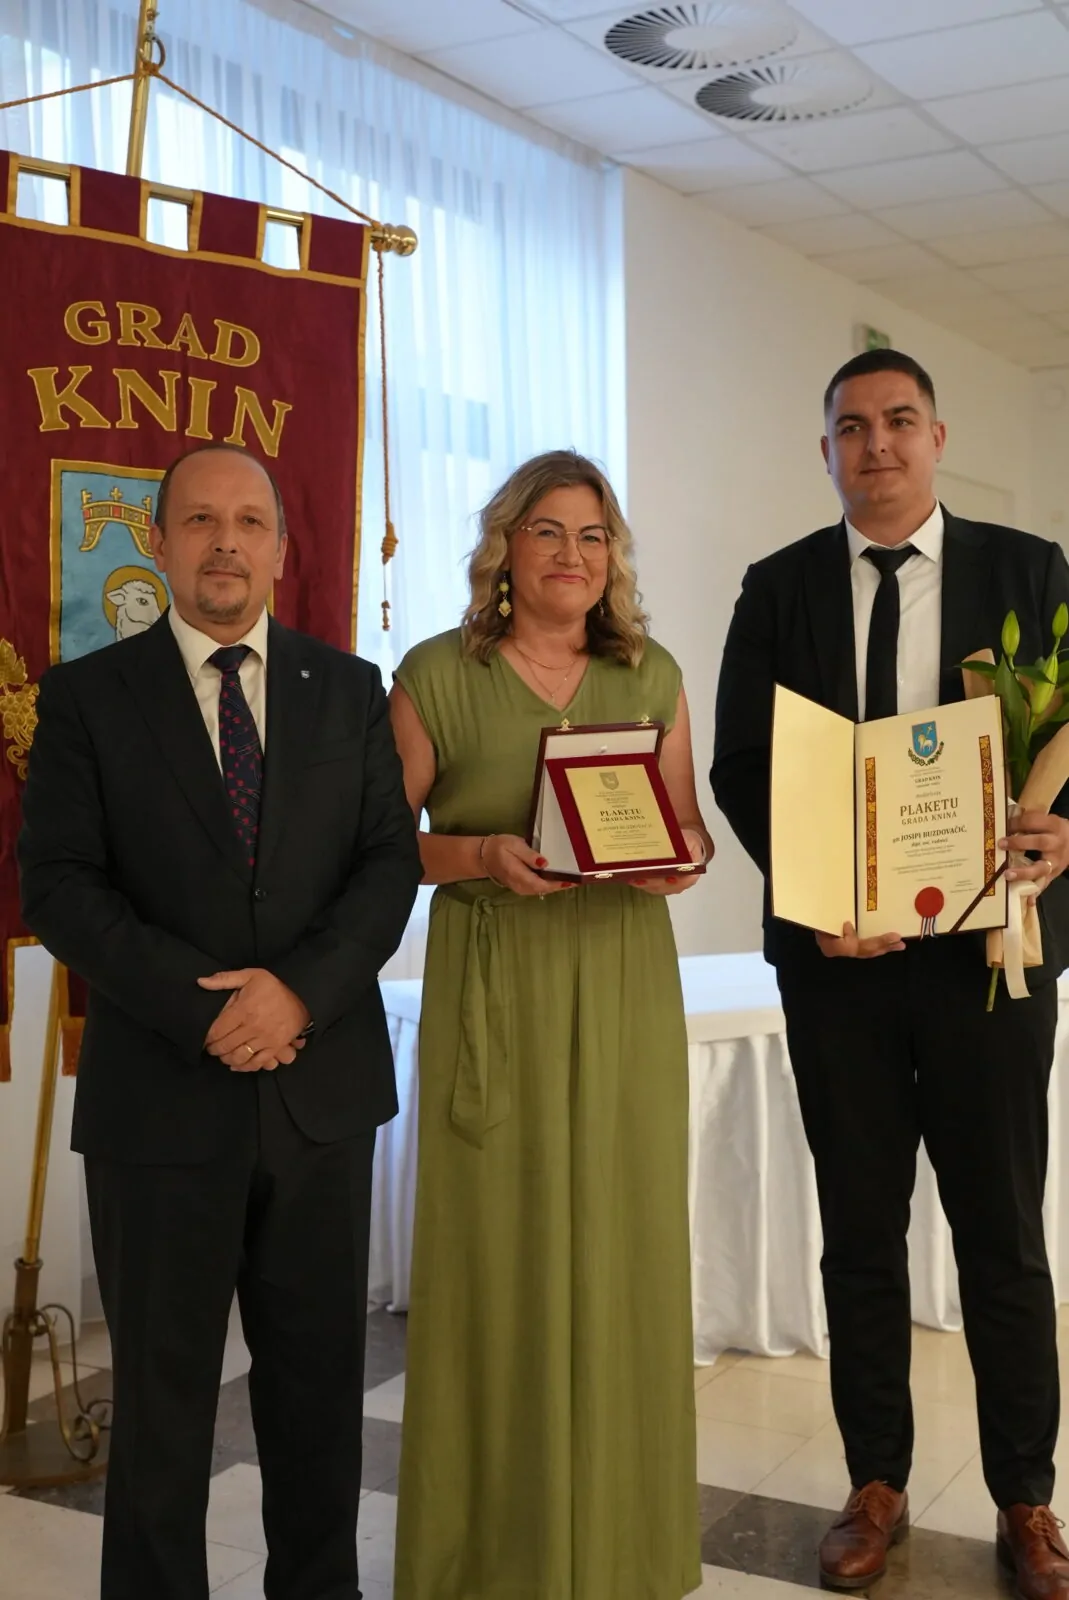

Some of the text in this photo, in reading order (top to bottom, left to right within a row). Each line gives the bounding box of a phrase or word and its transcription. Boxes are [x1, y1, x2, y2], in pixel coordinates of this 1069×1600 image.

[64, 300, 261, 367] GRAD
[27, 365, 292, 457] KNIN
[600, 808, 641, 817] PLAKETU
[899, 797, 959, 817] PLAKETU
[901, 811, 957, 826] GRADA KNINA
[901, 832, 921, 842] JOSIPI
